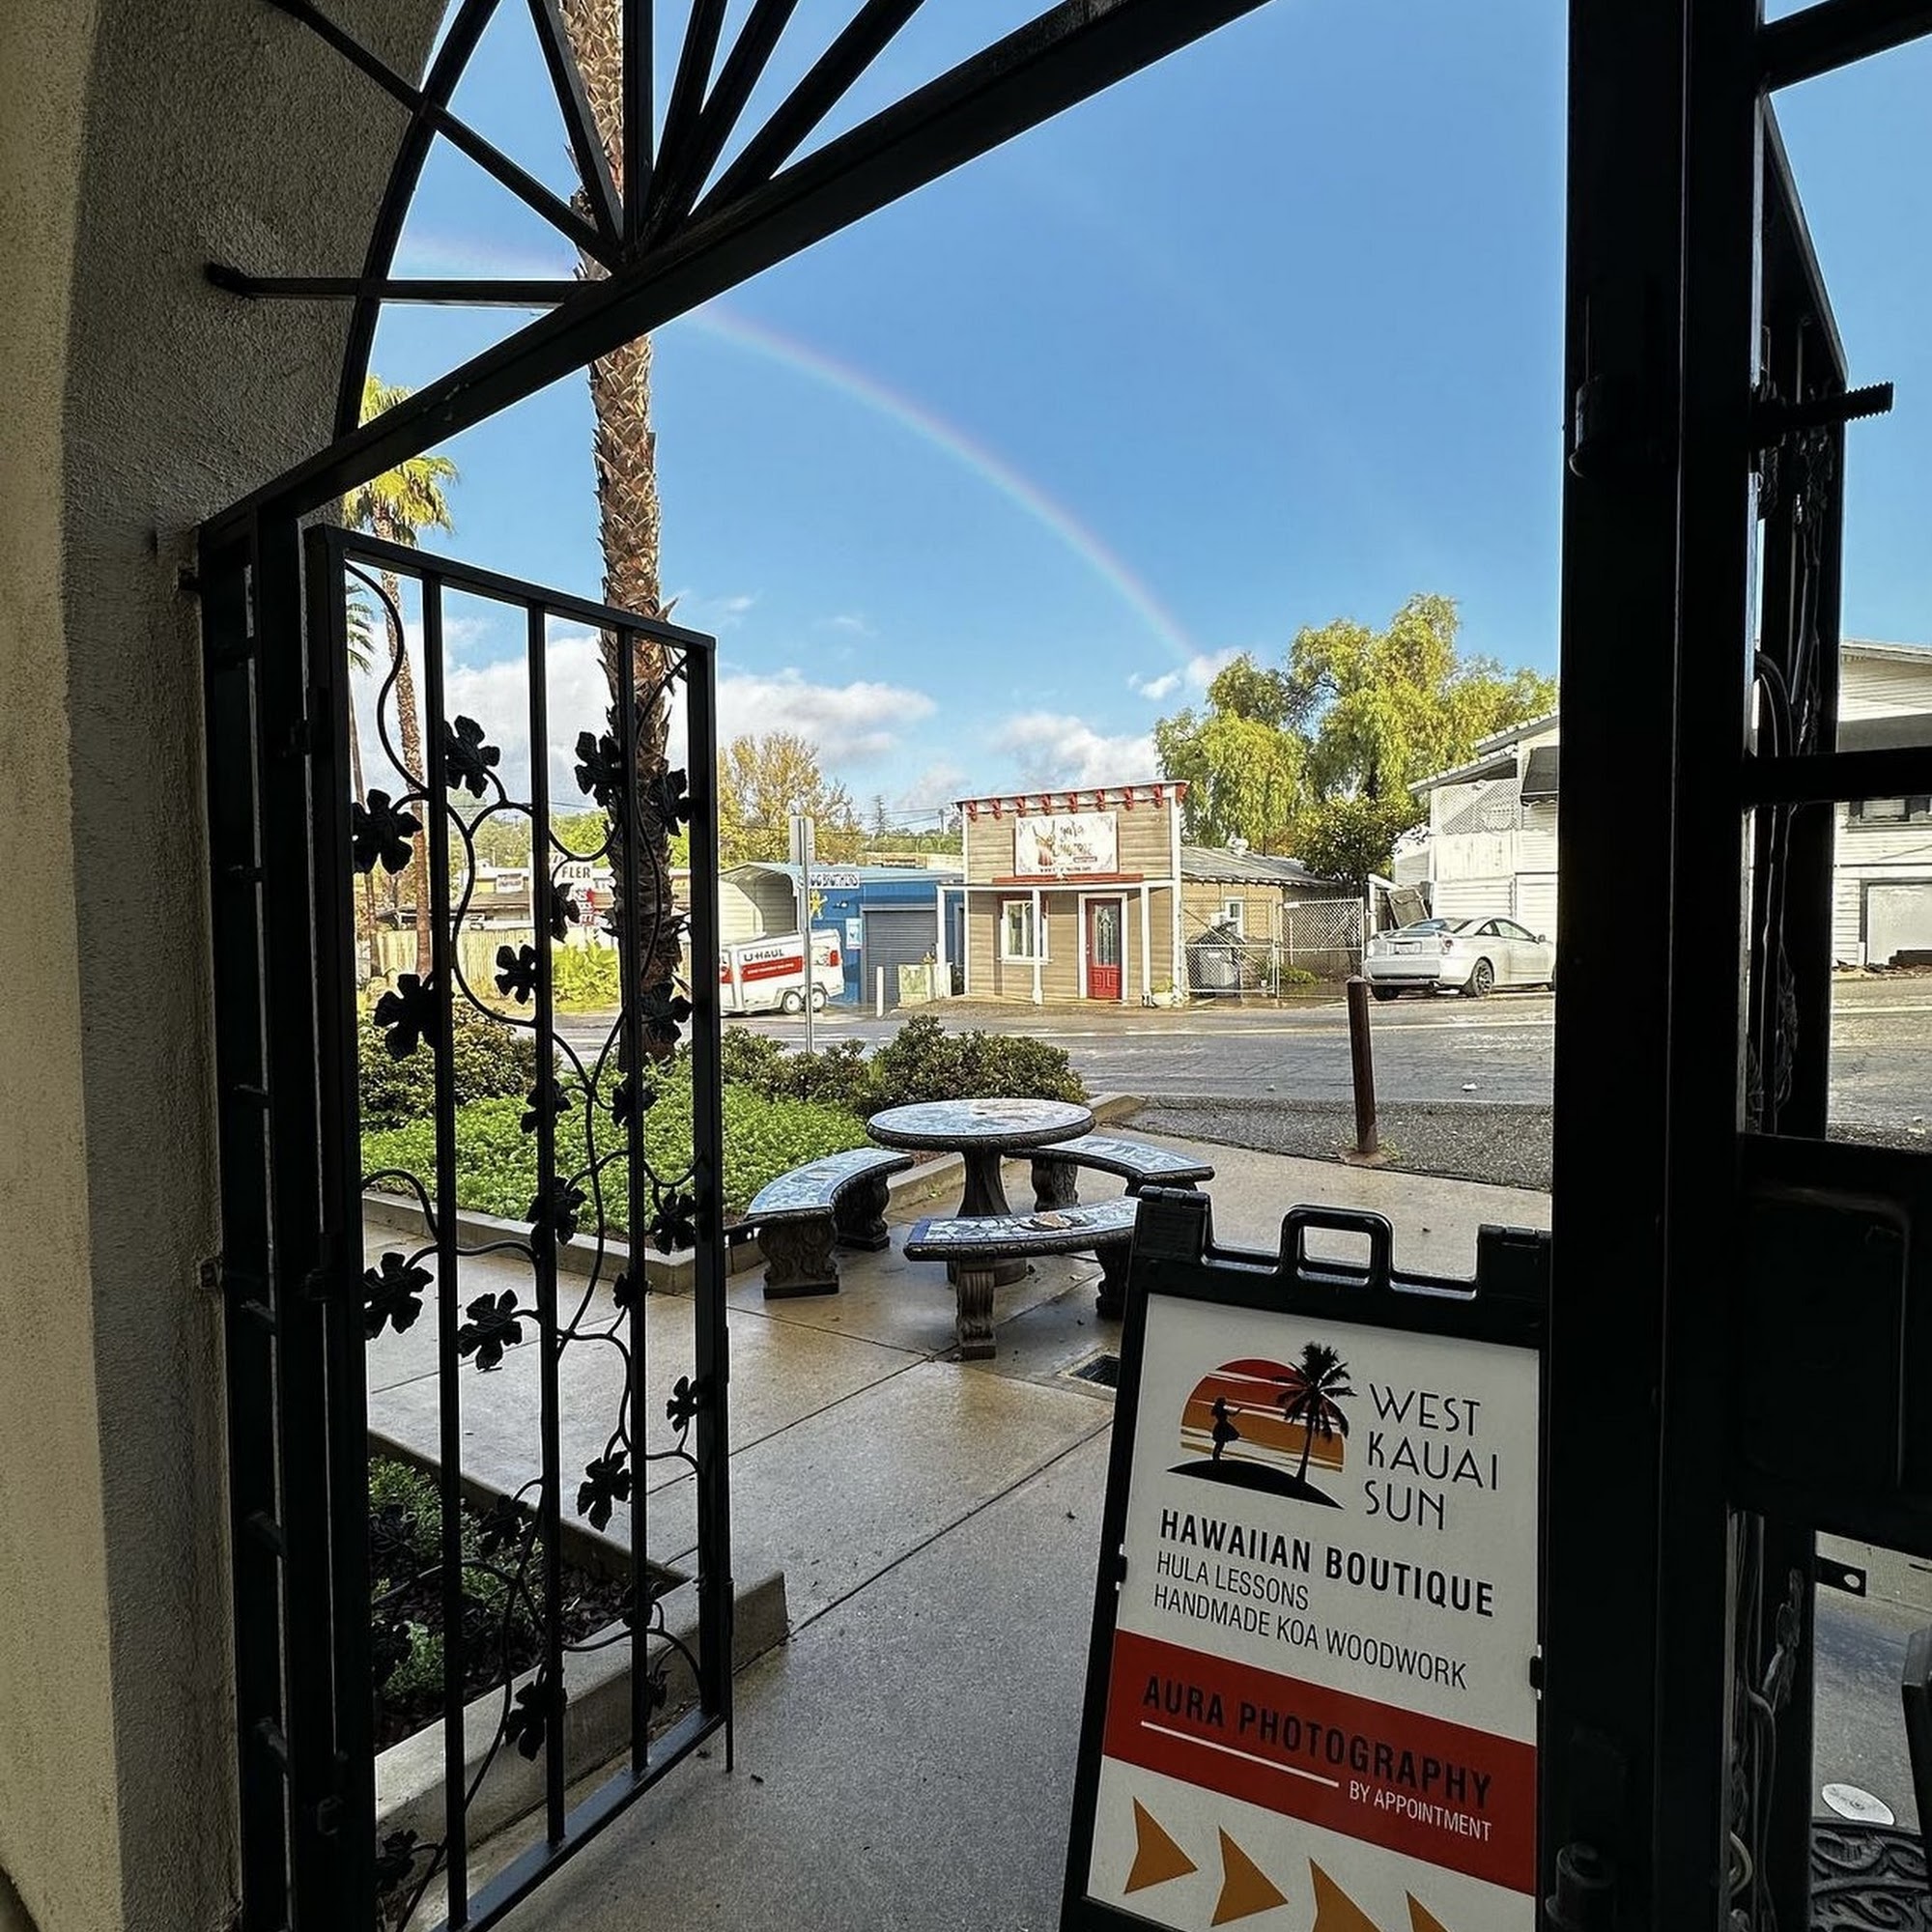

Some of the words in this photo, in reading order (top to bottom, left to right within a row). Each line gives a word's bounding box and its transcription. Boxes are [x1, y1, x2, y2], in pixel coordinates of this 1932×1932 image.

[1369, 1382, 1481, 1436] WEST
[1368, 1431, 1497, 1491] KAUAI
[1364, 1480, 1444, 1530] SUN
[1156, 1550, 1209, 1586] HULA
[1215, 1564, 1310, 1611] LESSONS
[1160, 1508, 1311, 1573] HAWAIIAN
[1325, 1546, 1494, 1617] BOUTIQUE
[1153, 1584, 1270, 1637] HANDMADE
[1276, 1615, 1320, 1651] KOA
[1325, 1627, 1468, 1690] WOODWORK
[1143, 1675, 1225, 1728] AURA
[1238, 1701, 1493, 1809] PHOTOGRAPHY
[1349, 1780, 1371, 1803] BY
[1373, 1788, 1492, 1842] APPOINTMENT
